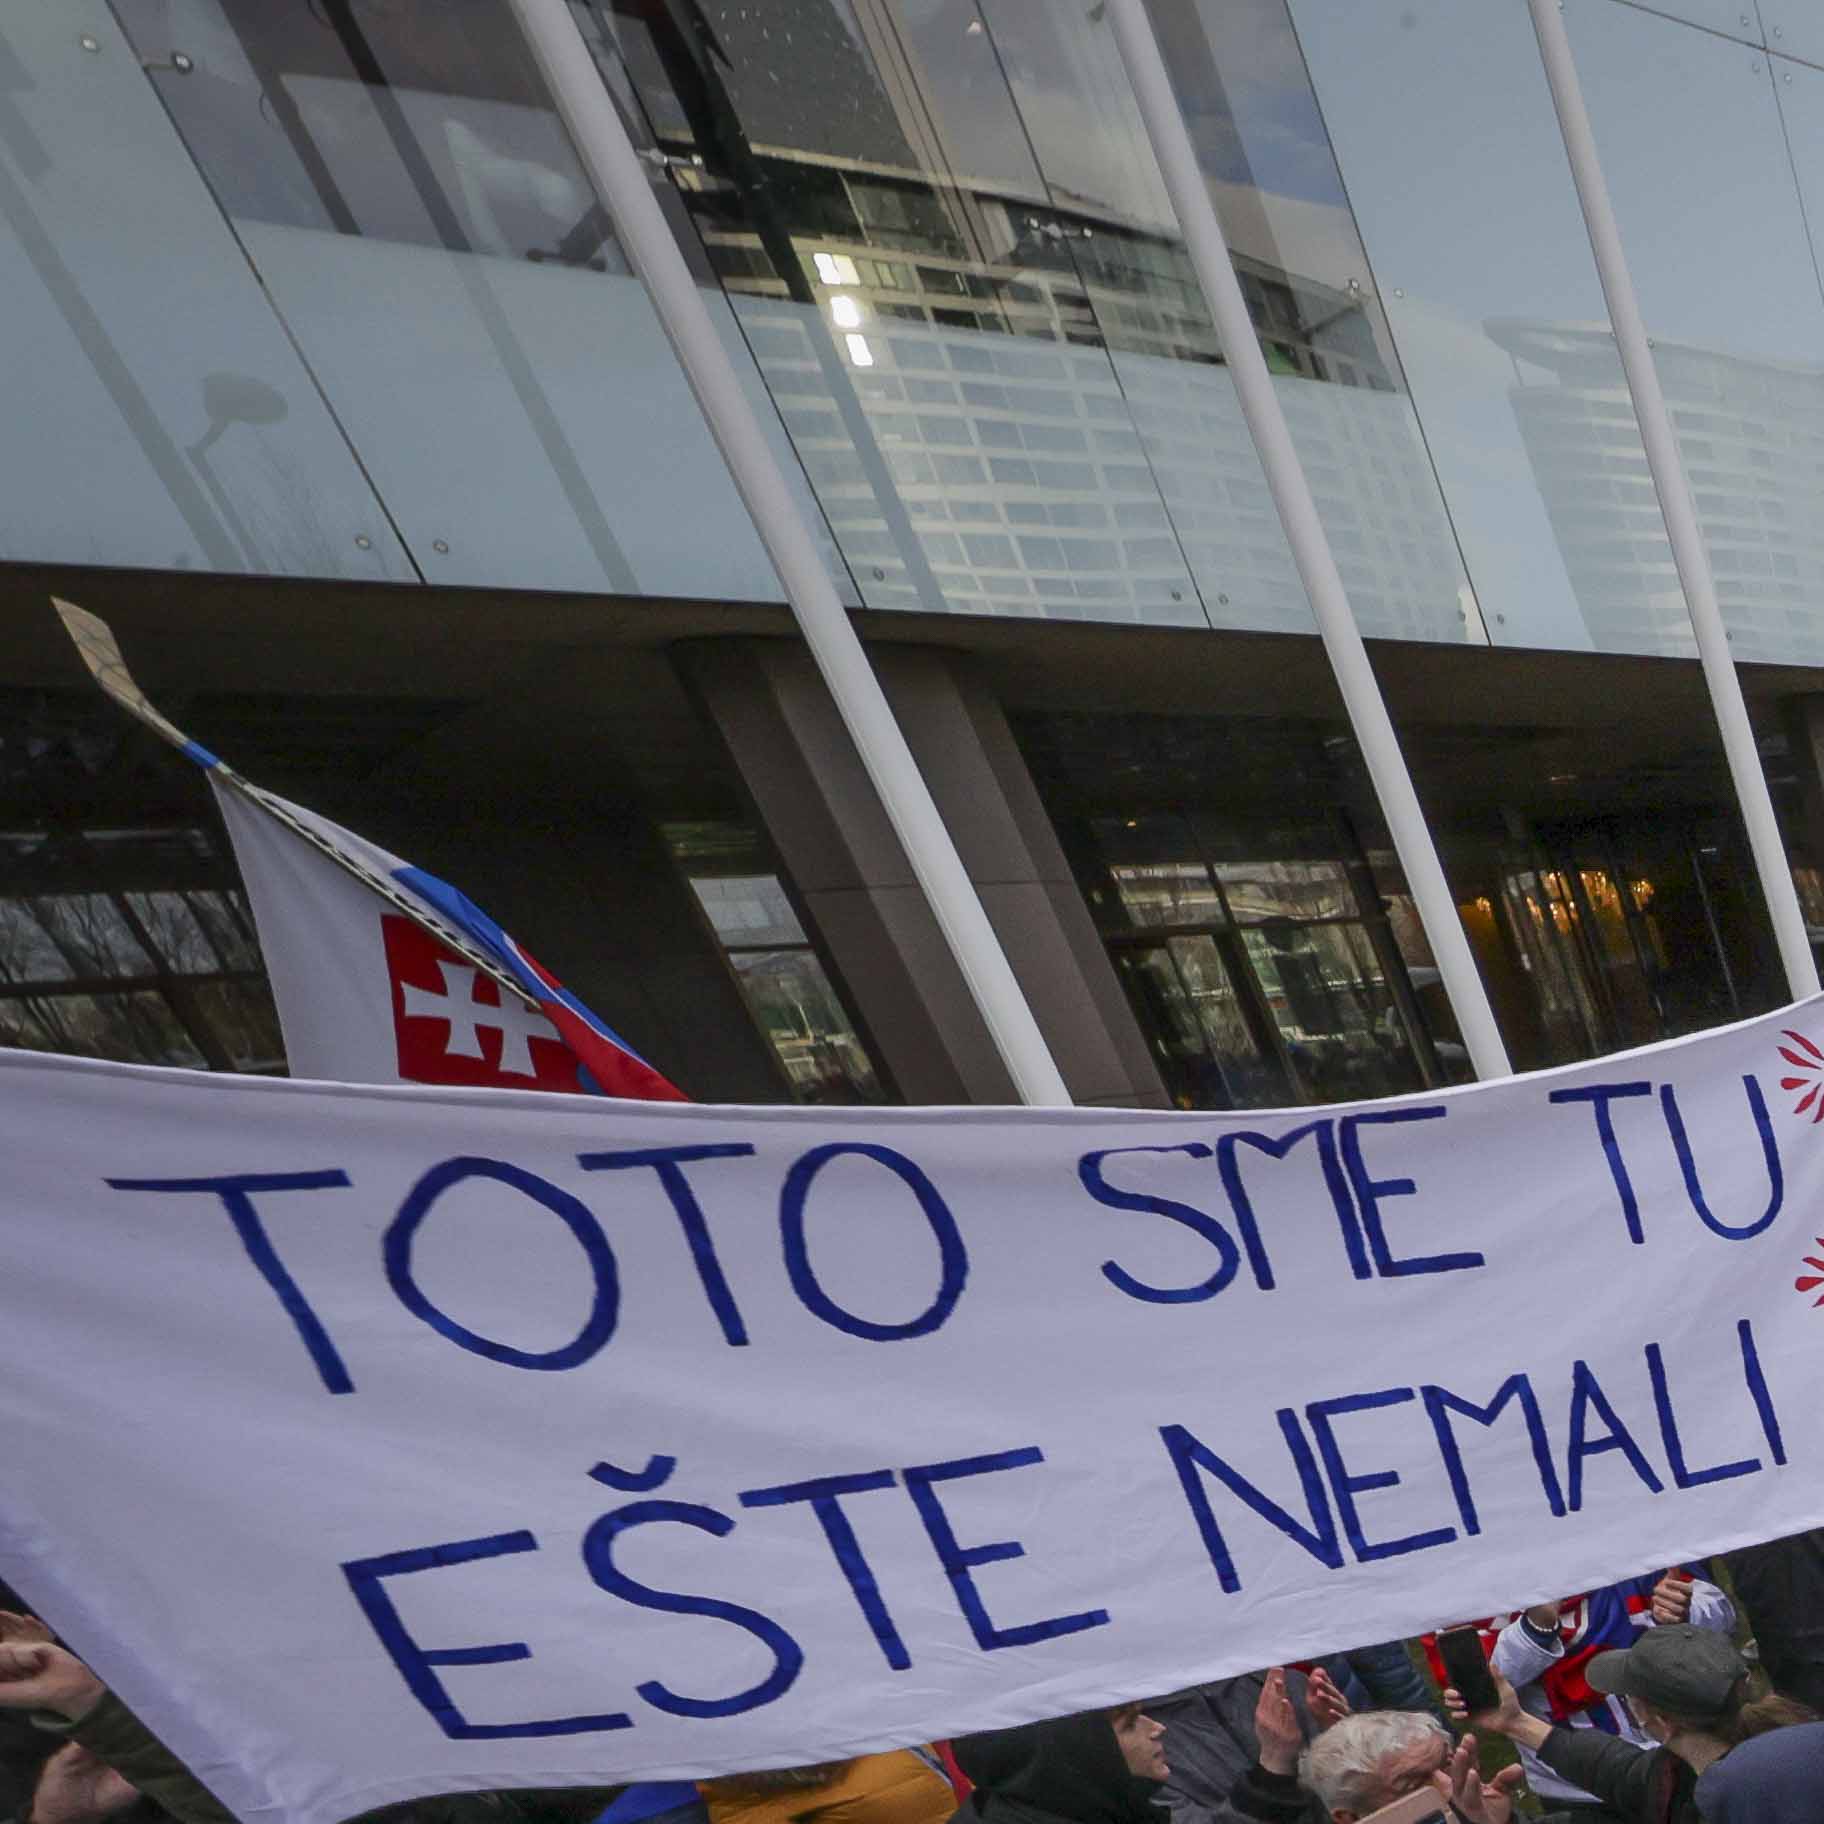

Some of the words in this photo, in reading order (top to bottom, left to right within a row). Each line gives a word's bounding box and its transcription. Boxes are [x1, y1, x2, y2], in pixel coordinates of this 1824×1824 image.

[104, 1142, 968, 1395] TOTO
[1078, 1106, 1485, 1305] SME
[1548, 1073, 1784, 1245] TU
[340, 1446, 1112, 1741] EŠTE
[1158, 1319, 1785, 1595] NEMALI
